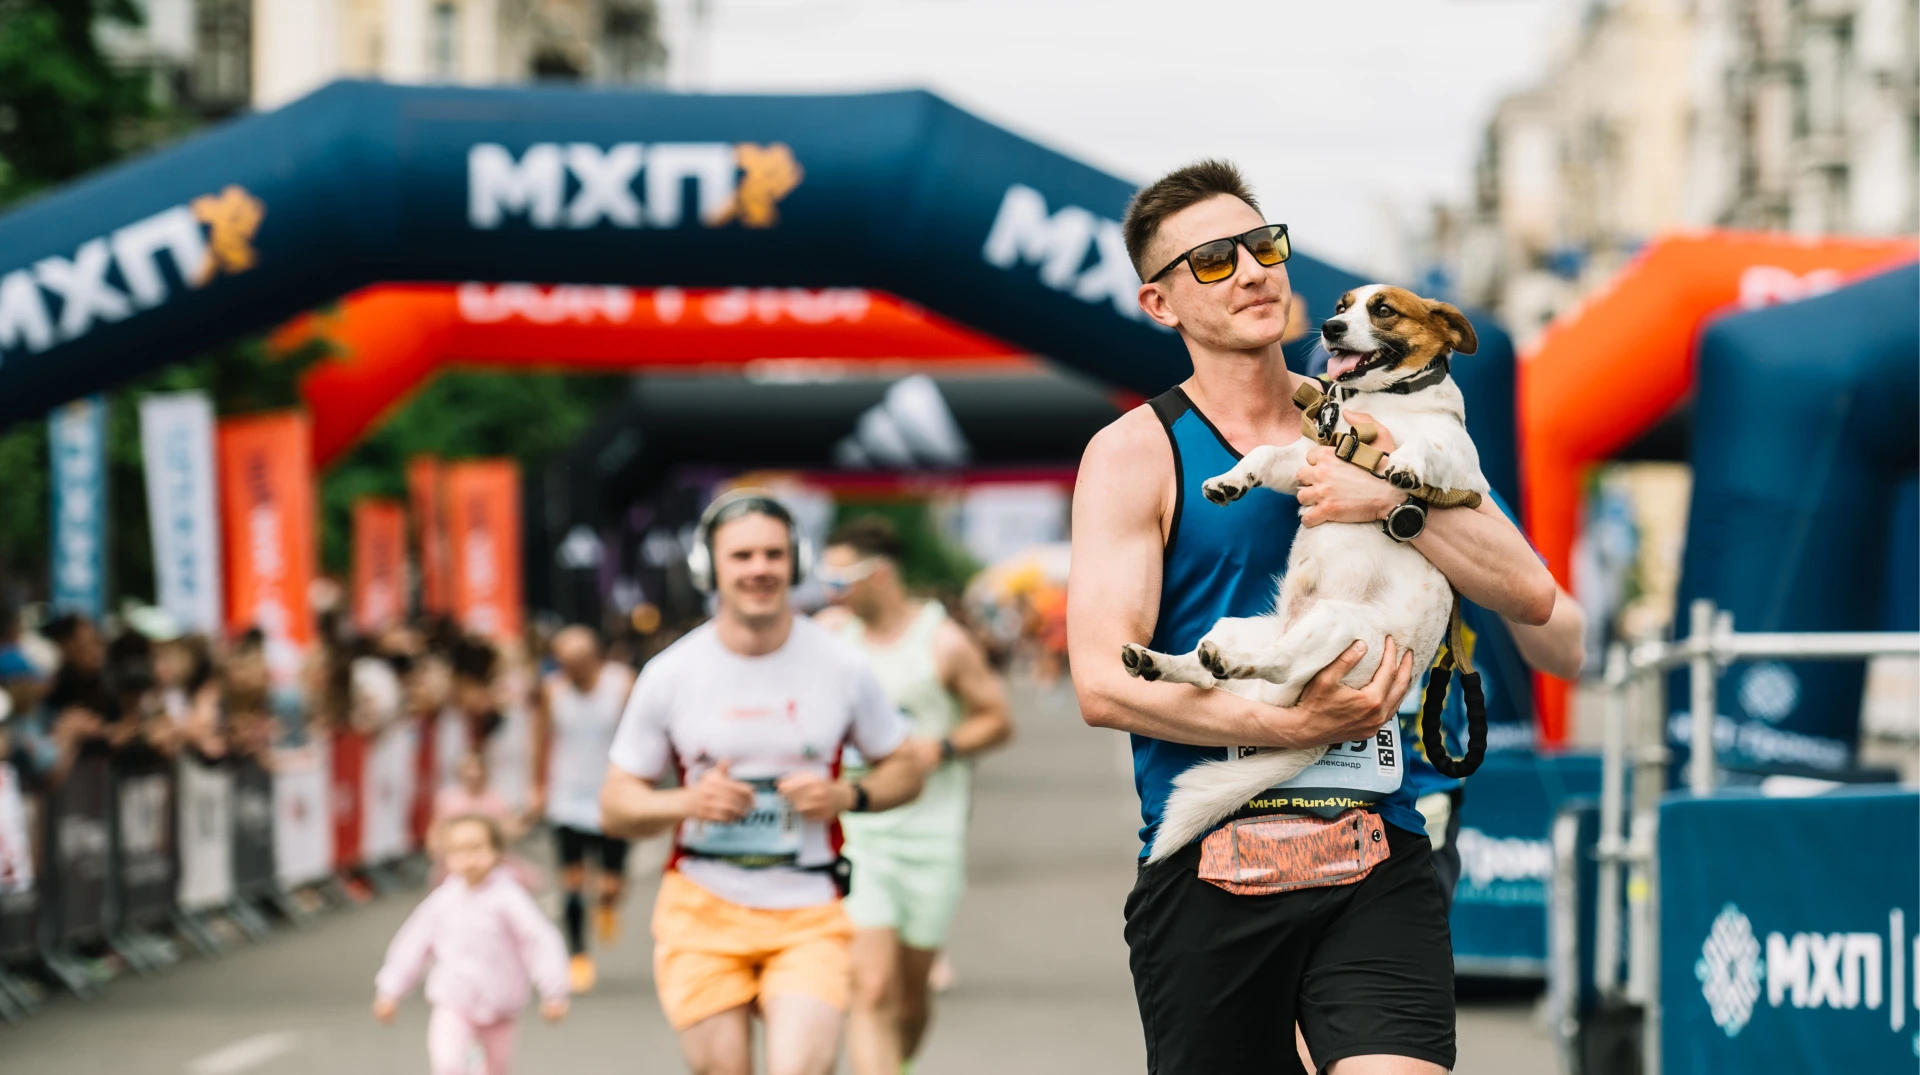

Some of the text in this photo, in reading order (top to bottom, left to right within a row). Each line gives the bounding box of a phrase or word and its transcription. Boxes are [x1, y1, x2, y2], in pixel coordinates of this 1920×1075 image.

[468, 142, 737, 228] МХП
[1249, 798, 1289, 809] MHP
[1766, 931, 1883, 1010] МХП
